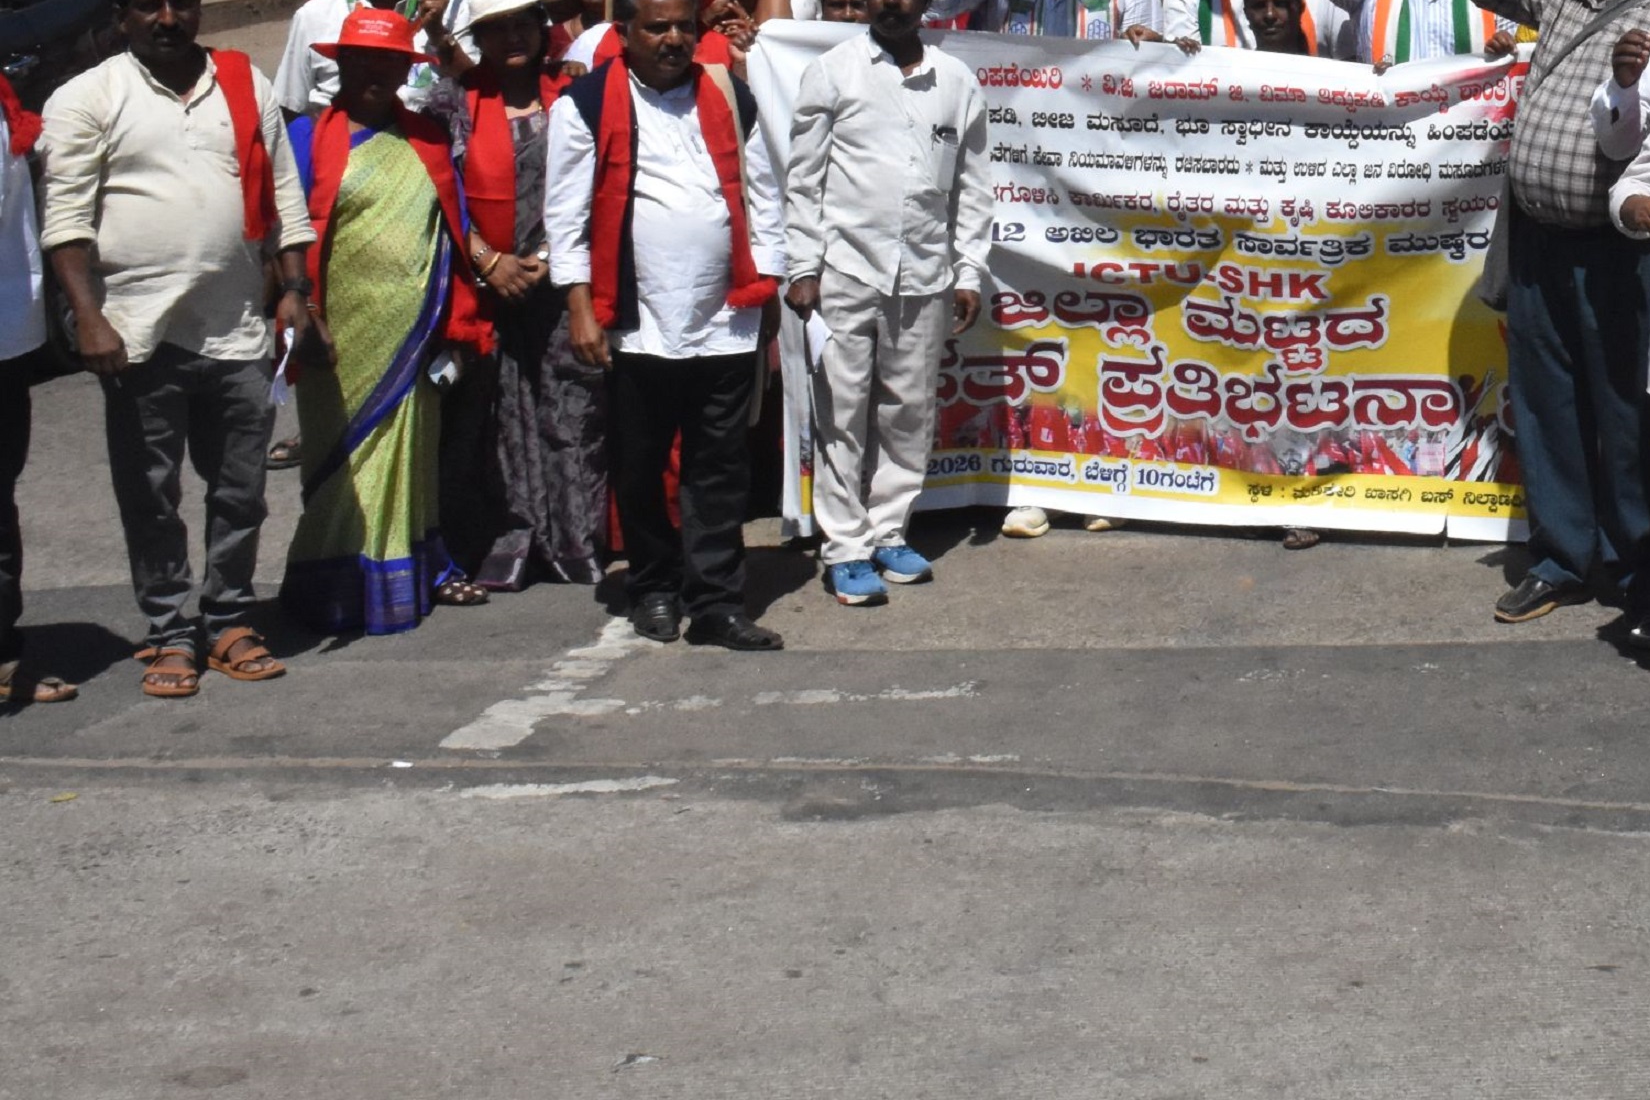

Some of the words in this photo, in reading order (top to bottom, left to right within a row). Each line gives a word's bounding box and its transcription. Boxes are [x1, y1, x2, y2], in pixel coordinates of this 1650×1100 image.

[977, 63, 1063, 89] ಂಪಡೆಯಿರಿ
[988, 106, 1022, 127] ಪಡಿ,
[1134, 226, 1221, 248] ಭಾರತ
[991, 290, 1151, 348] ಜಿಲ್ಲಾ
[1185, 296, 1386, 371] ಮಟ್ಟದ
[1101, 346, 1461, 439] ಪ್ರತಿಭಟನಾ
